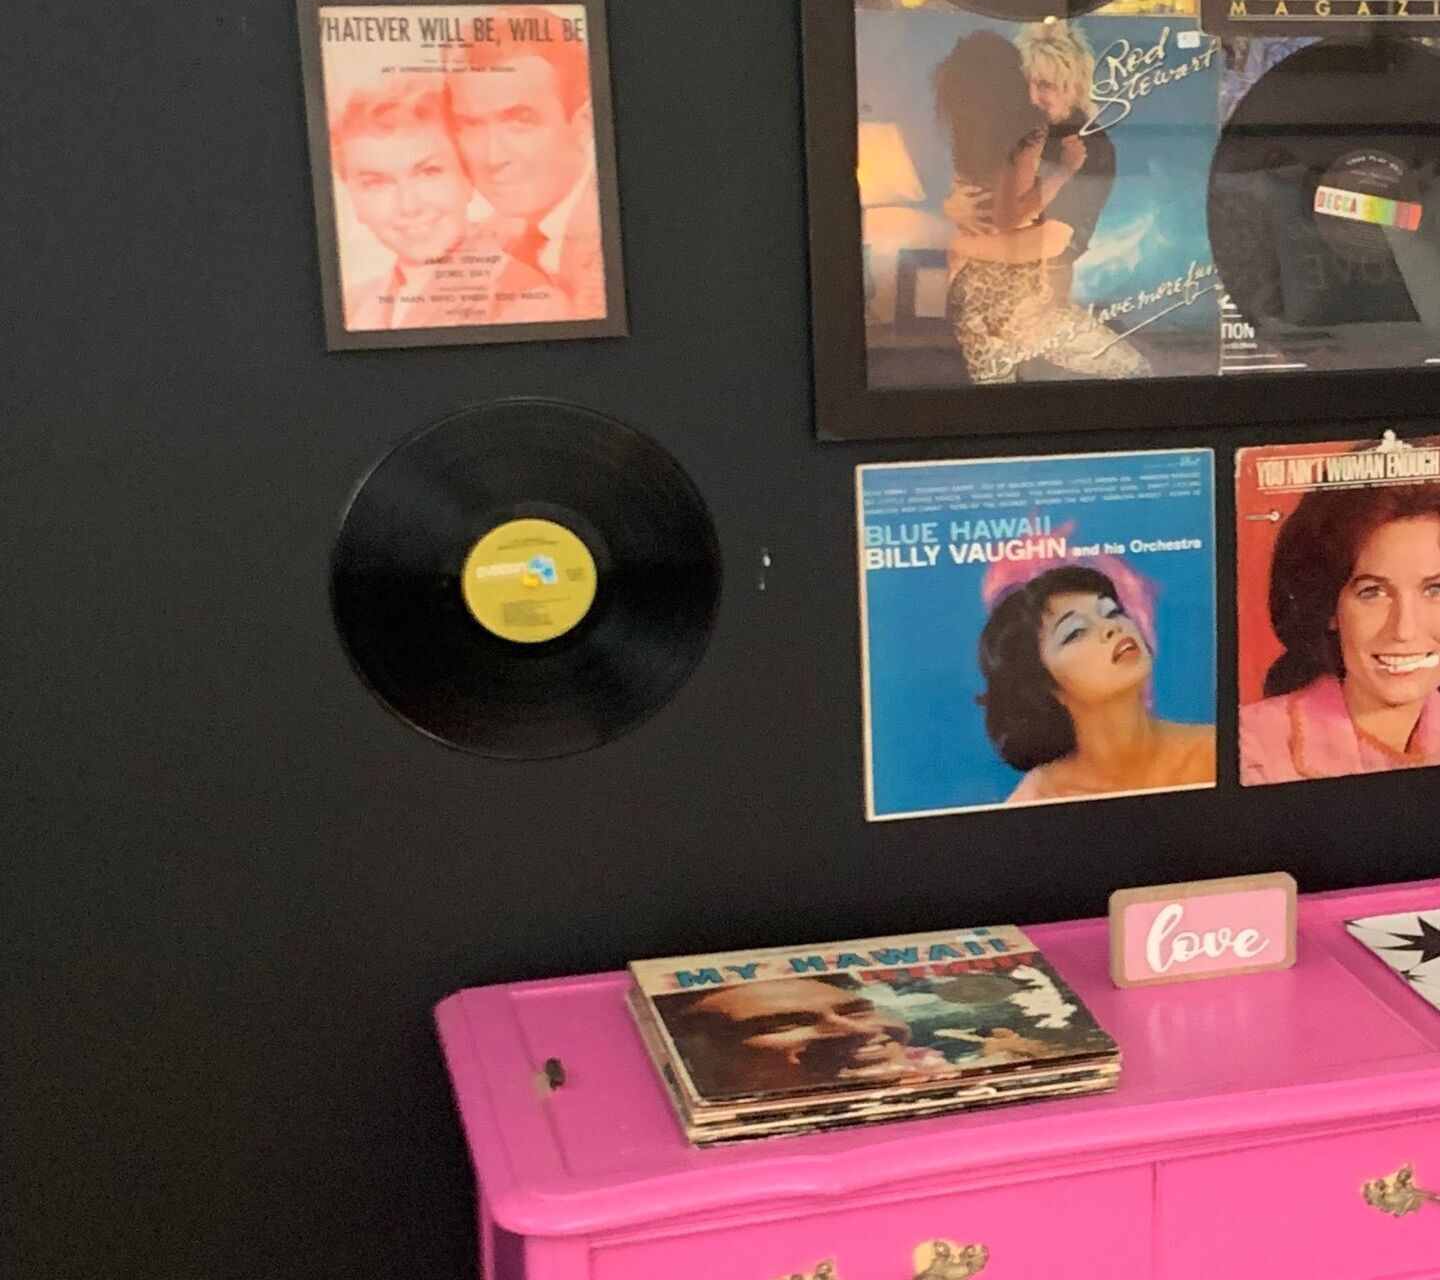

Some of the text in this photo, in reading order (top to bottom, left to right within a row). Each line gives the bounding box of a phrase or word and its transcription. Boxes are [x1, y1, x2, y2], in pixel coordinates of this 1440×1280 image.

[323, 17, 585, 47] HATEVER WILL BE, WILL BE
[1079, 36, 1223, 137] Stewart
[1316, 190, 1358, 215] DECCA
[1136, 276, 1185, 311] more
[1256, 460, 1285, 488] YOU
[1286, 457, 1325, 485] AIN'T
[1326, 453, 1385, 483] WOMAN
[865, 515, 1051, 546] BLUE HAWAII
[865, 537, 1203, 570] BILLY VAUGHN and his Orchestra
[1147, 903, 1271, 974] love
[673, 961, 761, 990] MY
[788, 937, 1012, 974] HAWAII
